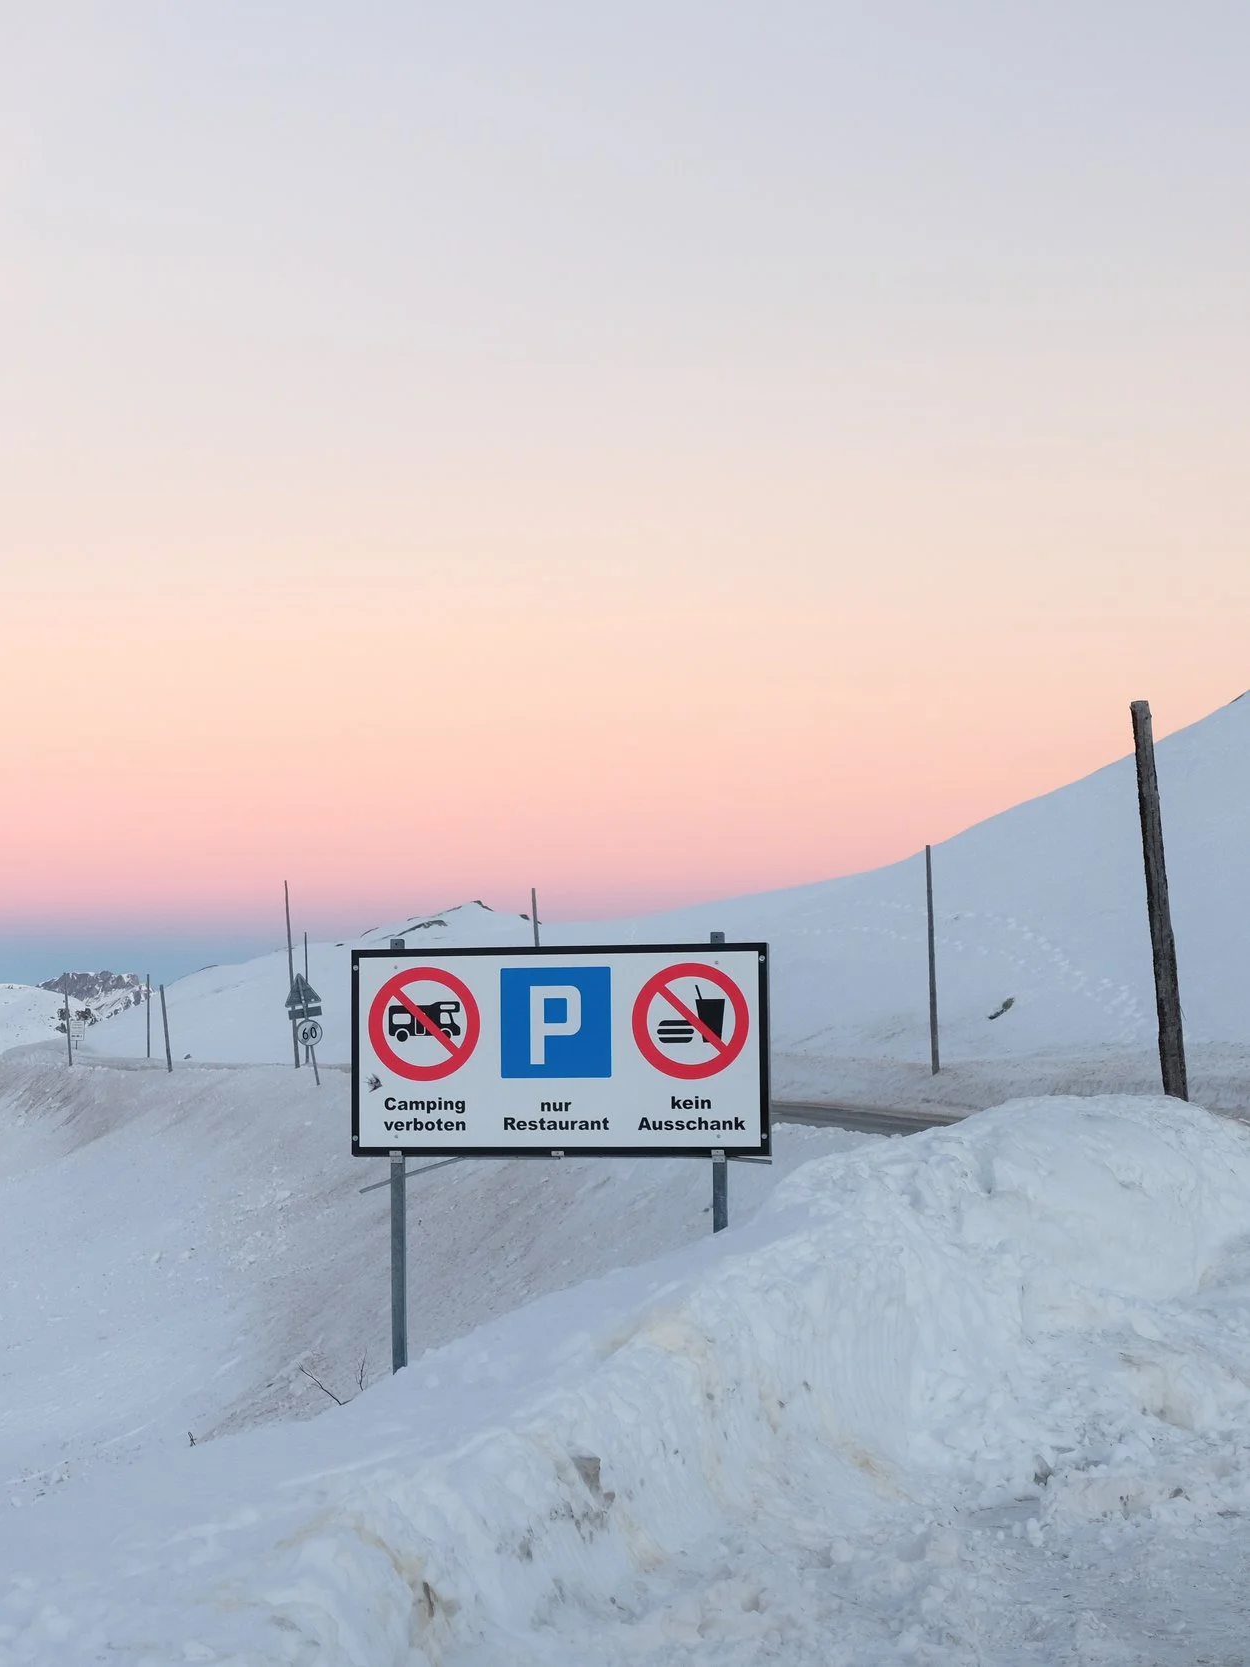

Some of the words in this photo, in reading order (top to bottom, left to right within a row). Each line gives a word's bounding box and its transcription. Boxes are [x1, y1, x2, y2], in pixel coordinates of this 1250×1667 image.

[530, 985, 582, 1065] P
[302, 1026, 317, 1040] 60
[384, 1097, 466, 1114] Camping
[540, 1101, 572, 1112] nur
[671, 1096, 712, 1110] kein
[384, 1118, 466, 1131] verboten
[503, 1117, 610, 1131] Restaurant
[638, 1117, 746, 1131] Ausschank
